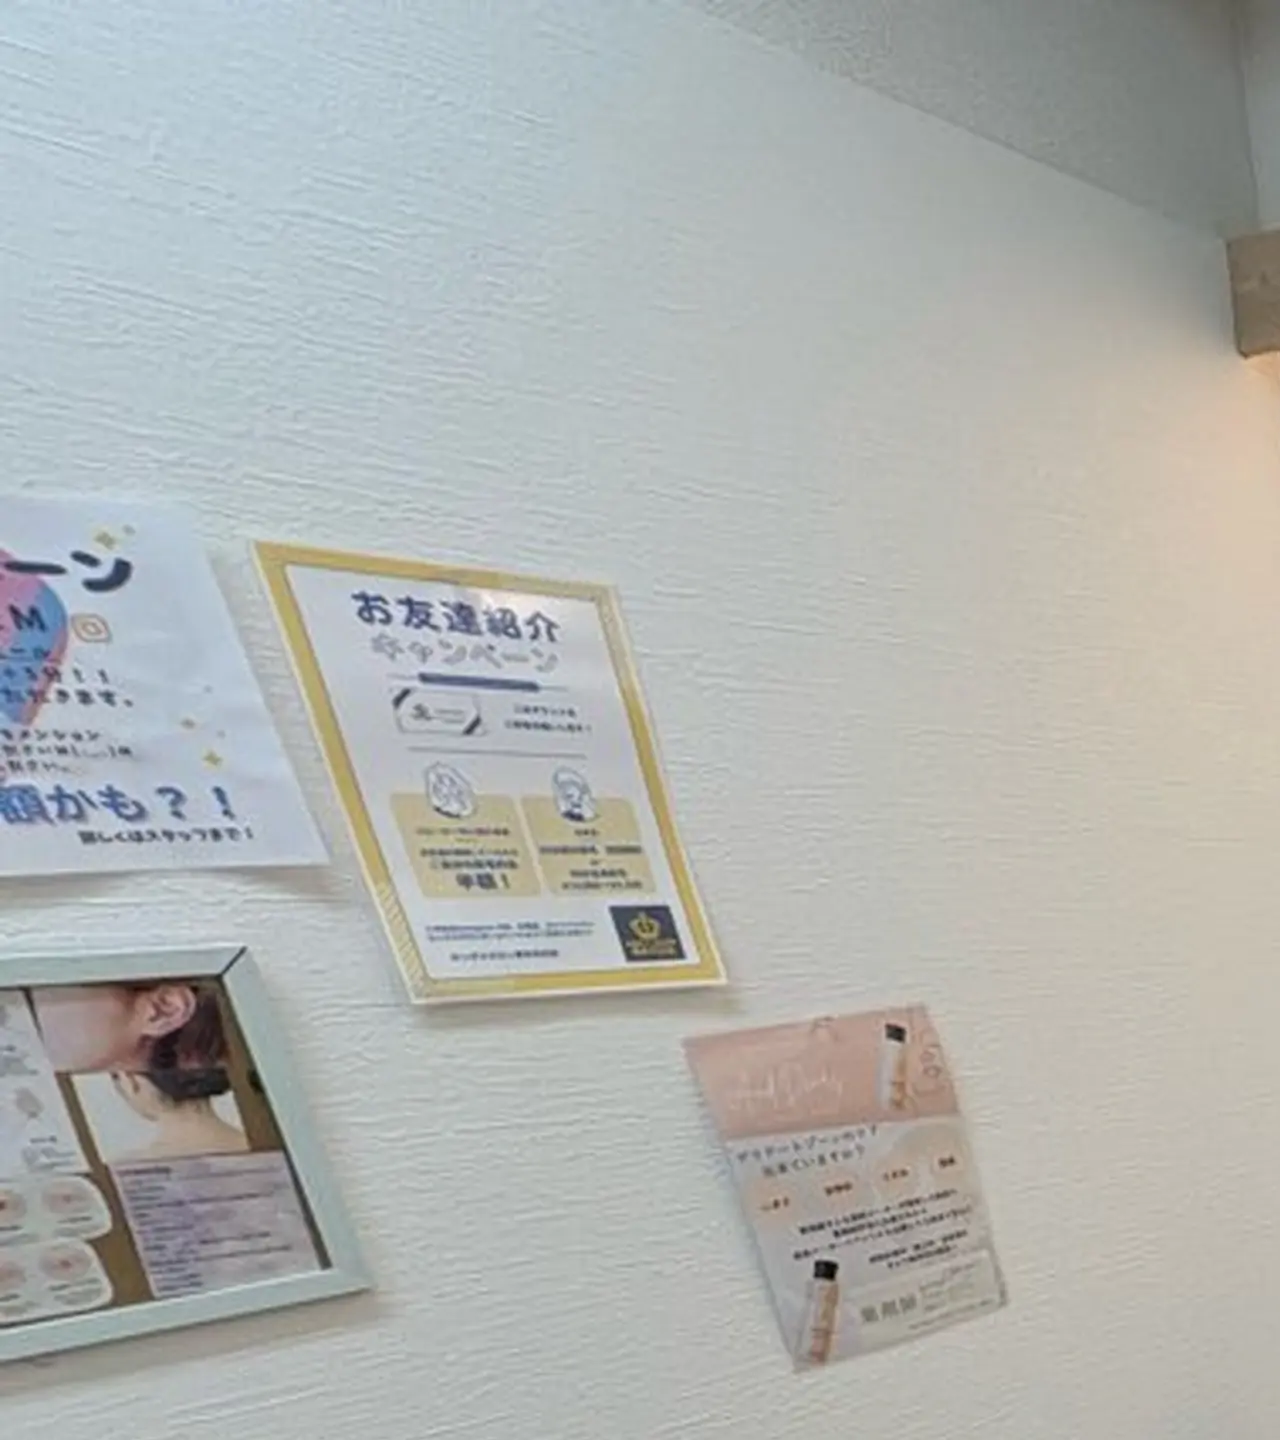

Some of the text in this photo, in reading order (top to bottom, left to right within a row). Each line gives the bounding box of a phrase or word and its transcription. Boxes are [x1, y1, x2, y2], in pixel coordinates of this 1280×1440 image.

[352, 592, 561, 644] お友達紹介
[371, 633, 558, 672] キャンペーン
